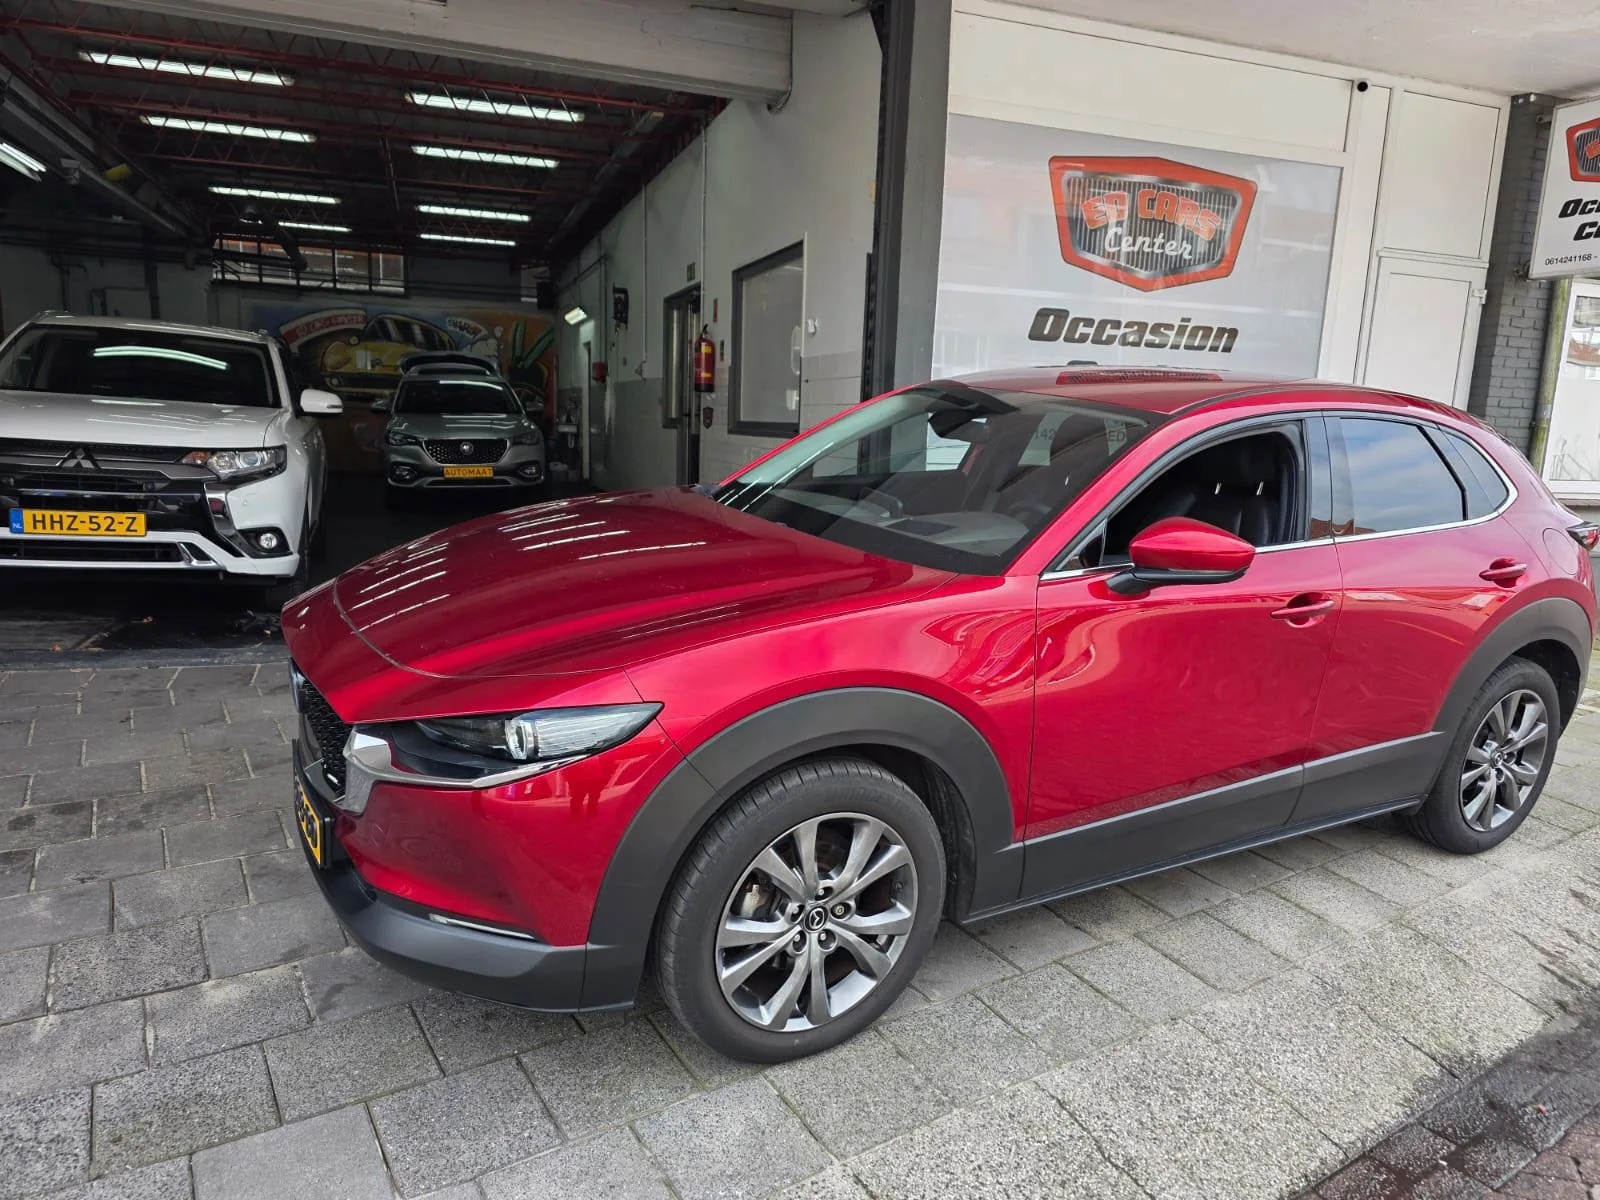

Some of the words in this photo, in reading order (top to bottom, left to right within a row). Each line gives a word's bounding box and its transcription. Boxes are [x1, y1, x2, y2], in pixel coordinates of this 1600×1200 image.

[1081, 191, 1128, 229] ED
[1138, 189, 1221, 241] CARS
[1104, 227, 1193, 260] Center
[1545, 253, 1592, 265] 0614241168
[1028, 307, 1239, 353] Occasion
[445, 468, 493, 476] AUTOMAAT
[32, 513, 138, 533] HHZ-52-Z
